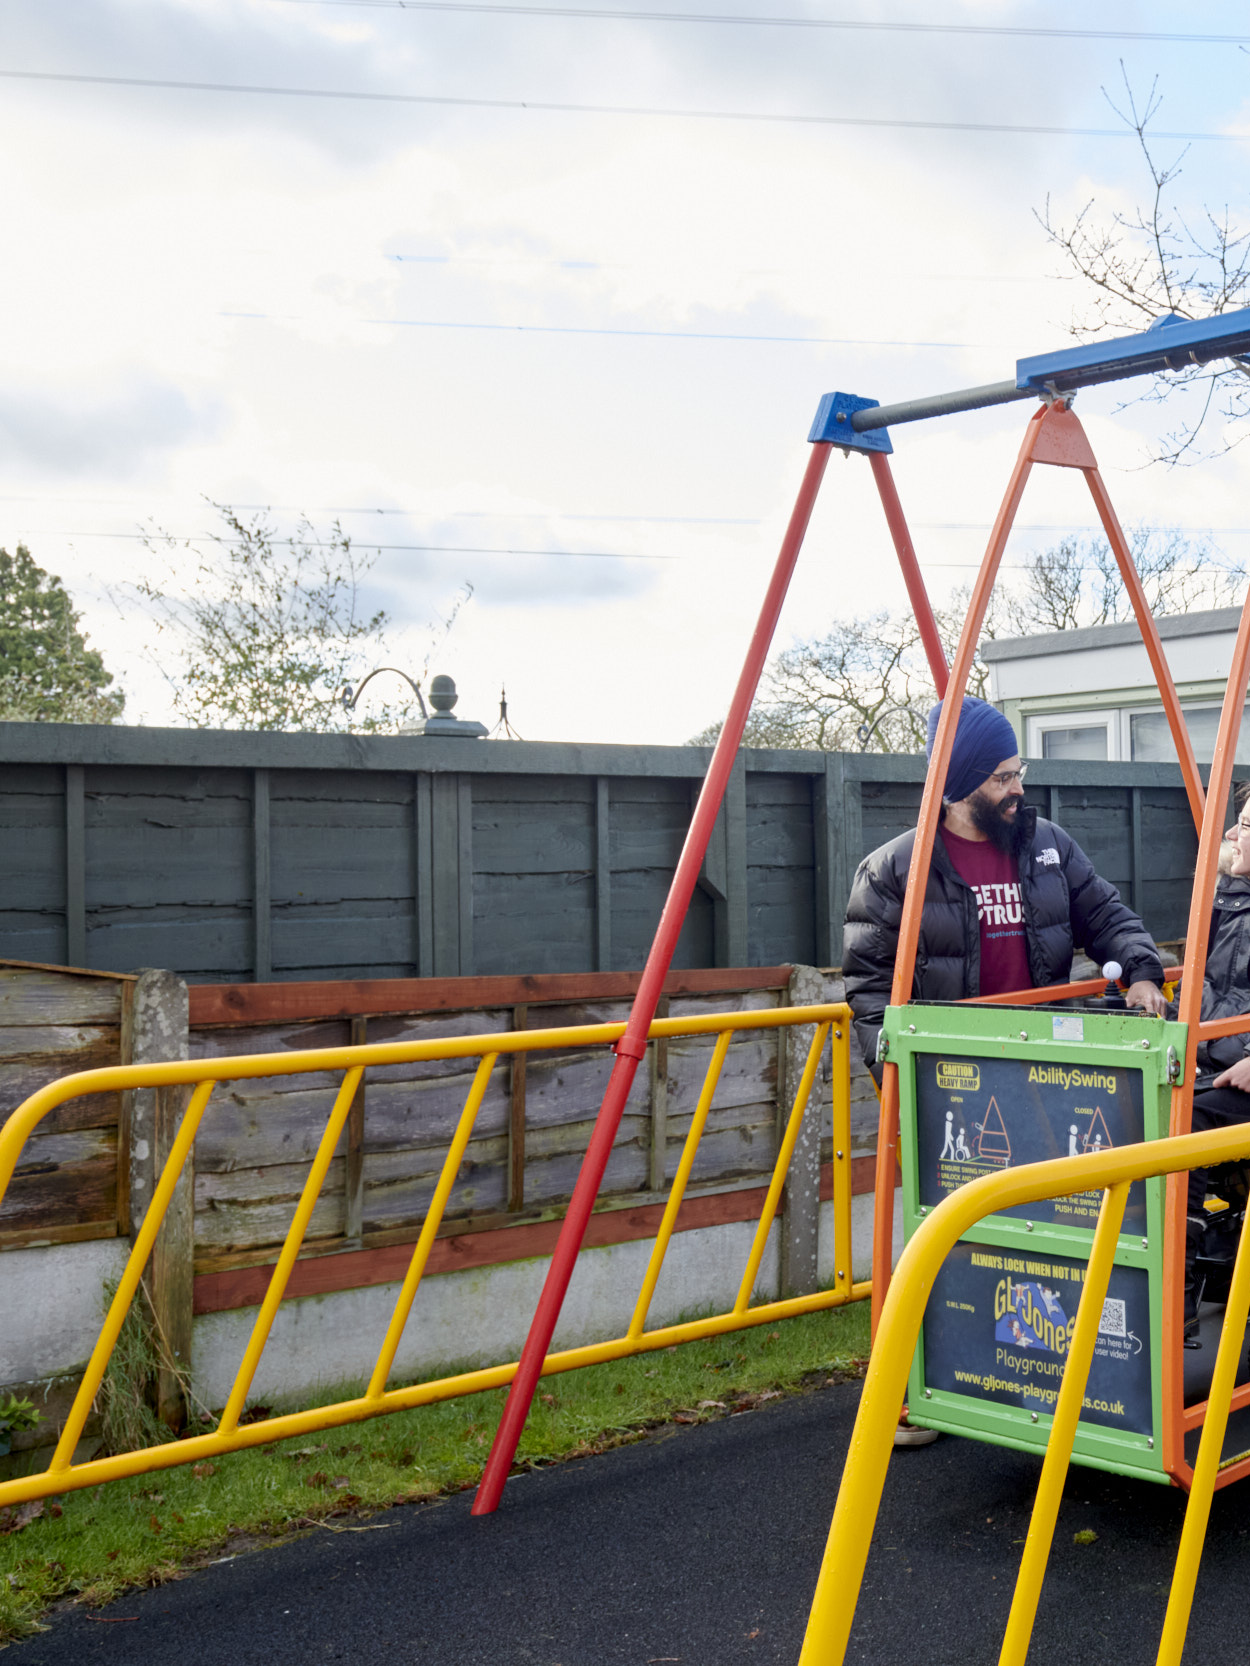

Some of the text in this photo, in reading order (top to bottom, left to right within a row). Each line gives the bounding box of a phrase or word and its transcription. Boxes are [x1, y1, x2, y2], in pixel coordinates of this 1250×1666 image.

[970, 882, 1023, 905] GETH
[942, 1064, 974, 1077] CAUTION
[940, 1077, 978, 1089] HEAVY RAMP
[1028, 1066, 1117, 1094] AbilitySwing
[1074, 1107, 1094, 1115] CLOSED
[1085, 1191, 1101, 1199] LOCK
[1055, 1204, 1073, 1214] PUSH
[1074, 1206, 1089, 1216] AND
[971, 1252, 1003, 1270] ALWAYS
[1004, 1257, 1026, 1274] LOCK
[1026, 1261, 1052, 1277] WHEN
[1052, 1265, 1070, 1280] NOT
[1070, 1268, 1081, 1282] IN
[994, 1276, 1017, 1321] GL
[1107, 1336, 1122, 1348] here
[1123, 1339, 1132, 1350] for
[1094, 1348, 1129, 1361] user video!
